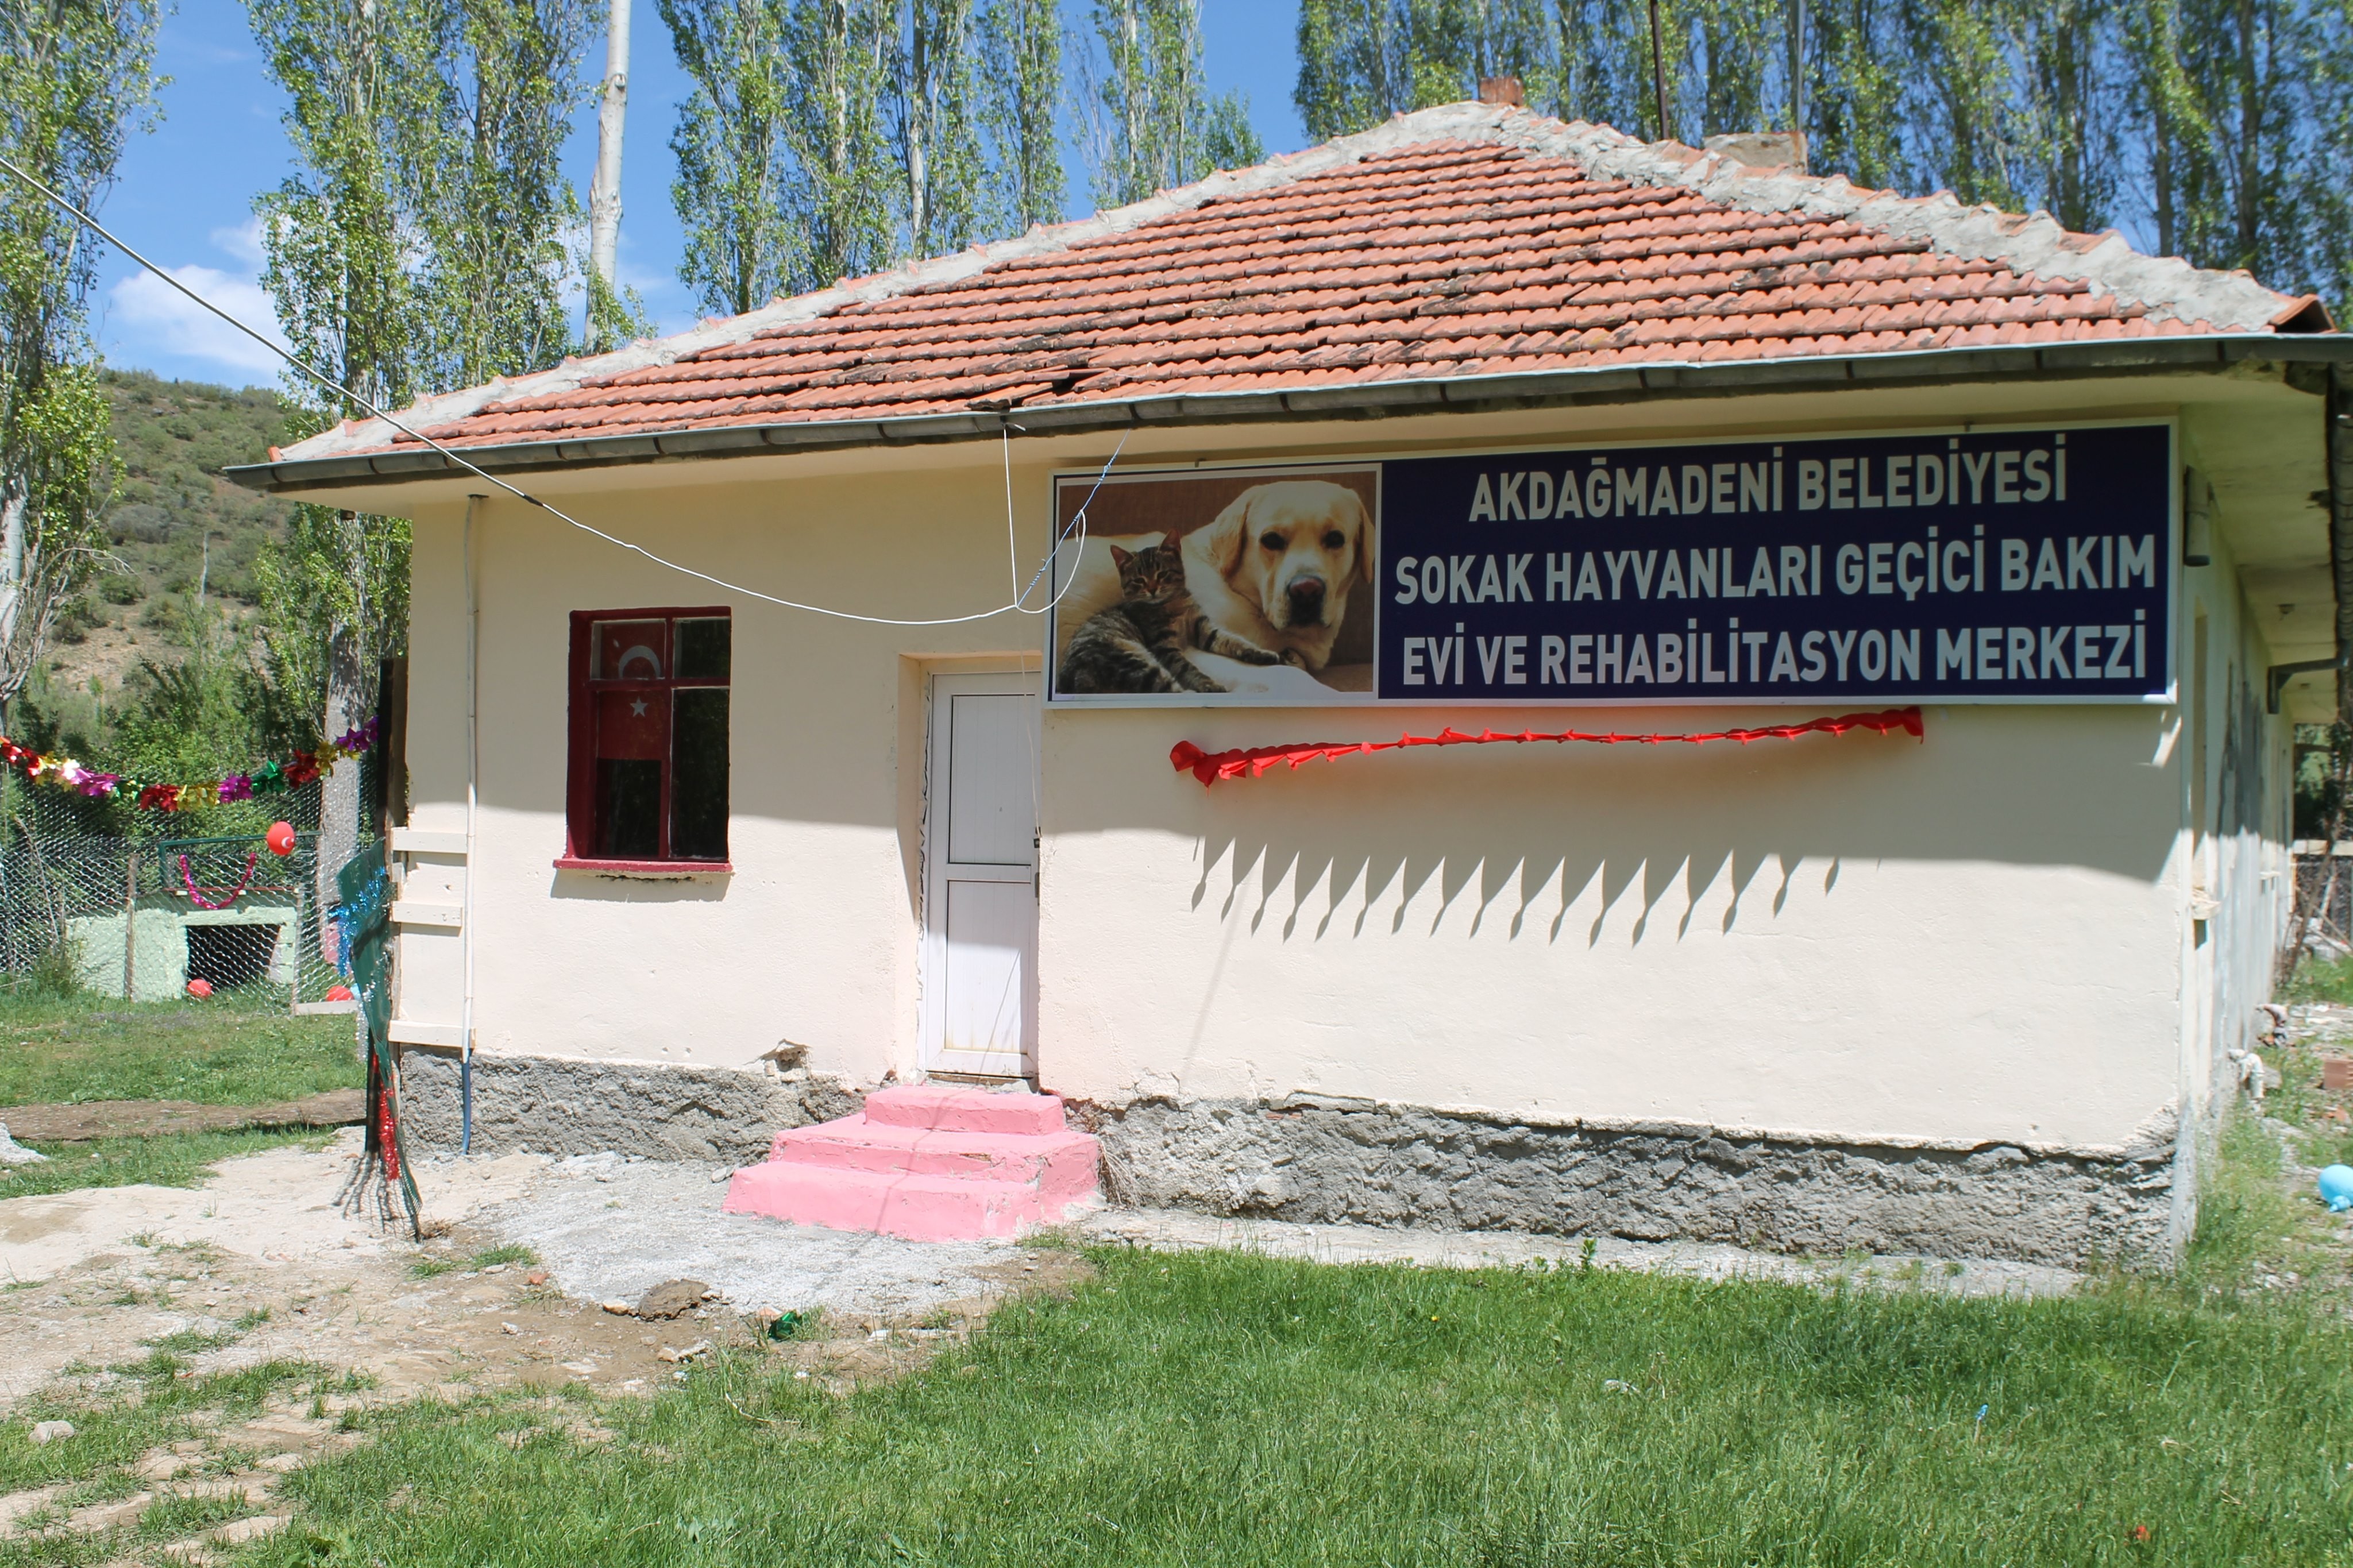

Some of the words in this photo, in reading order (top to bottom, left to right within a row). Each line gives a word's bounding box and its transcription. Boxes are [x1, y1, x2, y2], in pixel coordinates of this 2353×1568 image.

[1468, 447, 1783, 522] AKDAĞMADENİ
[1798, 434, 2066, 511] BELEDİYESİ
[1394, 550, 1534, 605] SOKAK
[1546, 545, 1821, 601] HAYVANLARI
[1836, 524, 1984, 601] GEÇİCİ
[2001, 534, 2155, 592] BAKIM
[1403, 622, 1465, 685] EVİ
[1475, 635, 1527, 685] VE
[1541, 617, 1920, 685] REHABİLİTASYON
[1936, 608, 2146, 681] MERKEZİ
